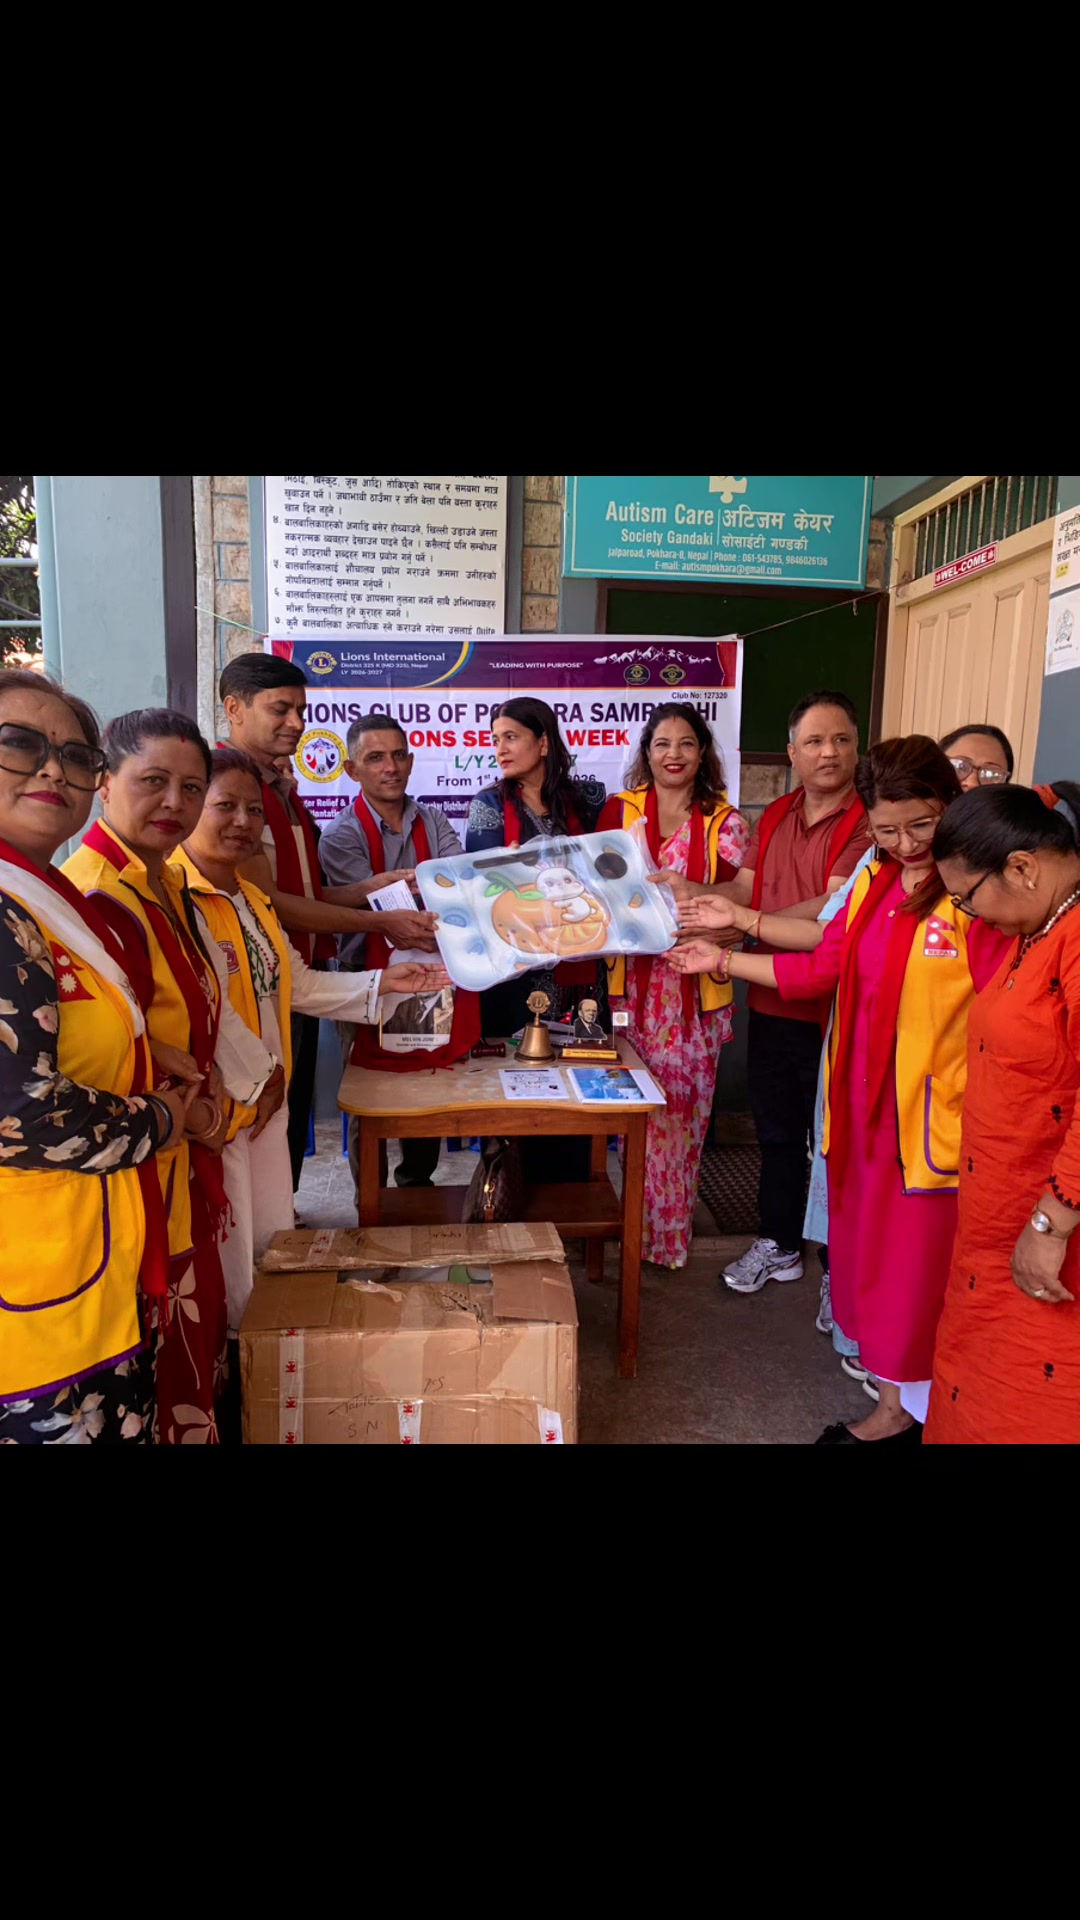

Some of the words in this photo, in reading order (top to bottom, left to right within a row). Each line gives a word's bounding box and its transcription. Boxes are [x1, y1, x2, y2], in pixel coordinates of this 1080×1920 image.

[387, 478, 419, 491] तोकिएको
[423, 482, 441, 491] स्थान
[445, 484, 451, 493] र
[455, 484, 480, 493] समयमा
[484, 486, 498, 494] मात्र
[395, 495, 401, 504] र
[606, 501, 667, 523] Autism
[674, 504, 714, 526] Care
[722, 504, 785, 530] अटिजम
[793, 508, 834, 534] केयर
[621, 528, 663, 546] Society
[667, 530, 713, 546] Gandaki
[771, 536, 808, 551] गण्डकी
[362, 552, 376, 560] मात्र
[688, 551, 708, 560] Nepal
[714, 552, 736, 562] Phone
[655, 561, 680, 570] E-mail:
[942, 552, 988, 580] WEL-COME
[350, 593, 362, 603] एक
[341, 652, 370, 660] Lions
[374, 652, 446, 660] International
[304, 704, 362, 723] IONS
[438, 704, 468, 724] OF
[590, 702, 717, 722] SAMRHI
[566, 729, 630, 746] WEEK
[454, 755, 484, 772] L/Y
[437, 776, 472, 786] From
[316, 798, 338, 806] Relief
[340, 798, 346, 806] &
